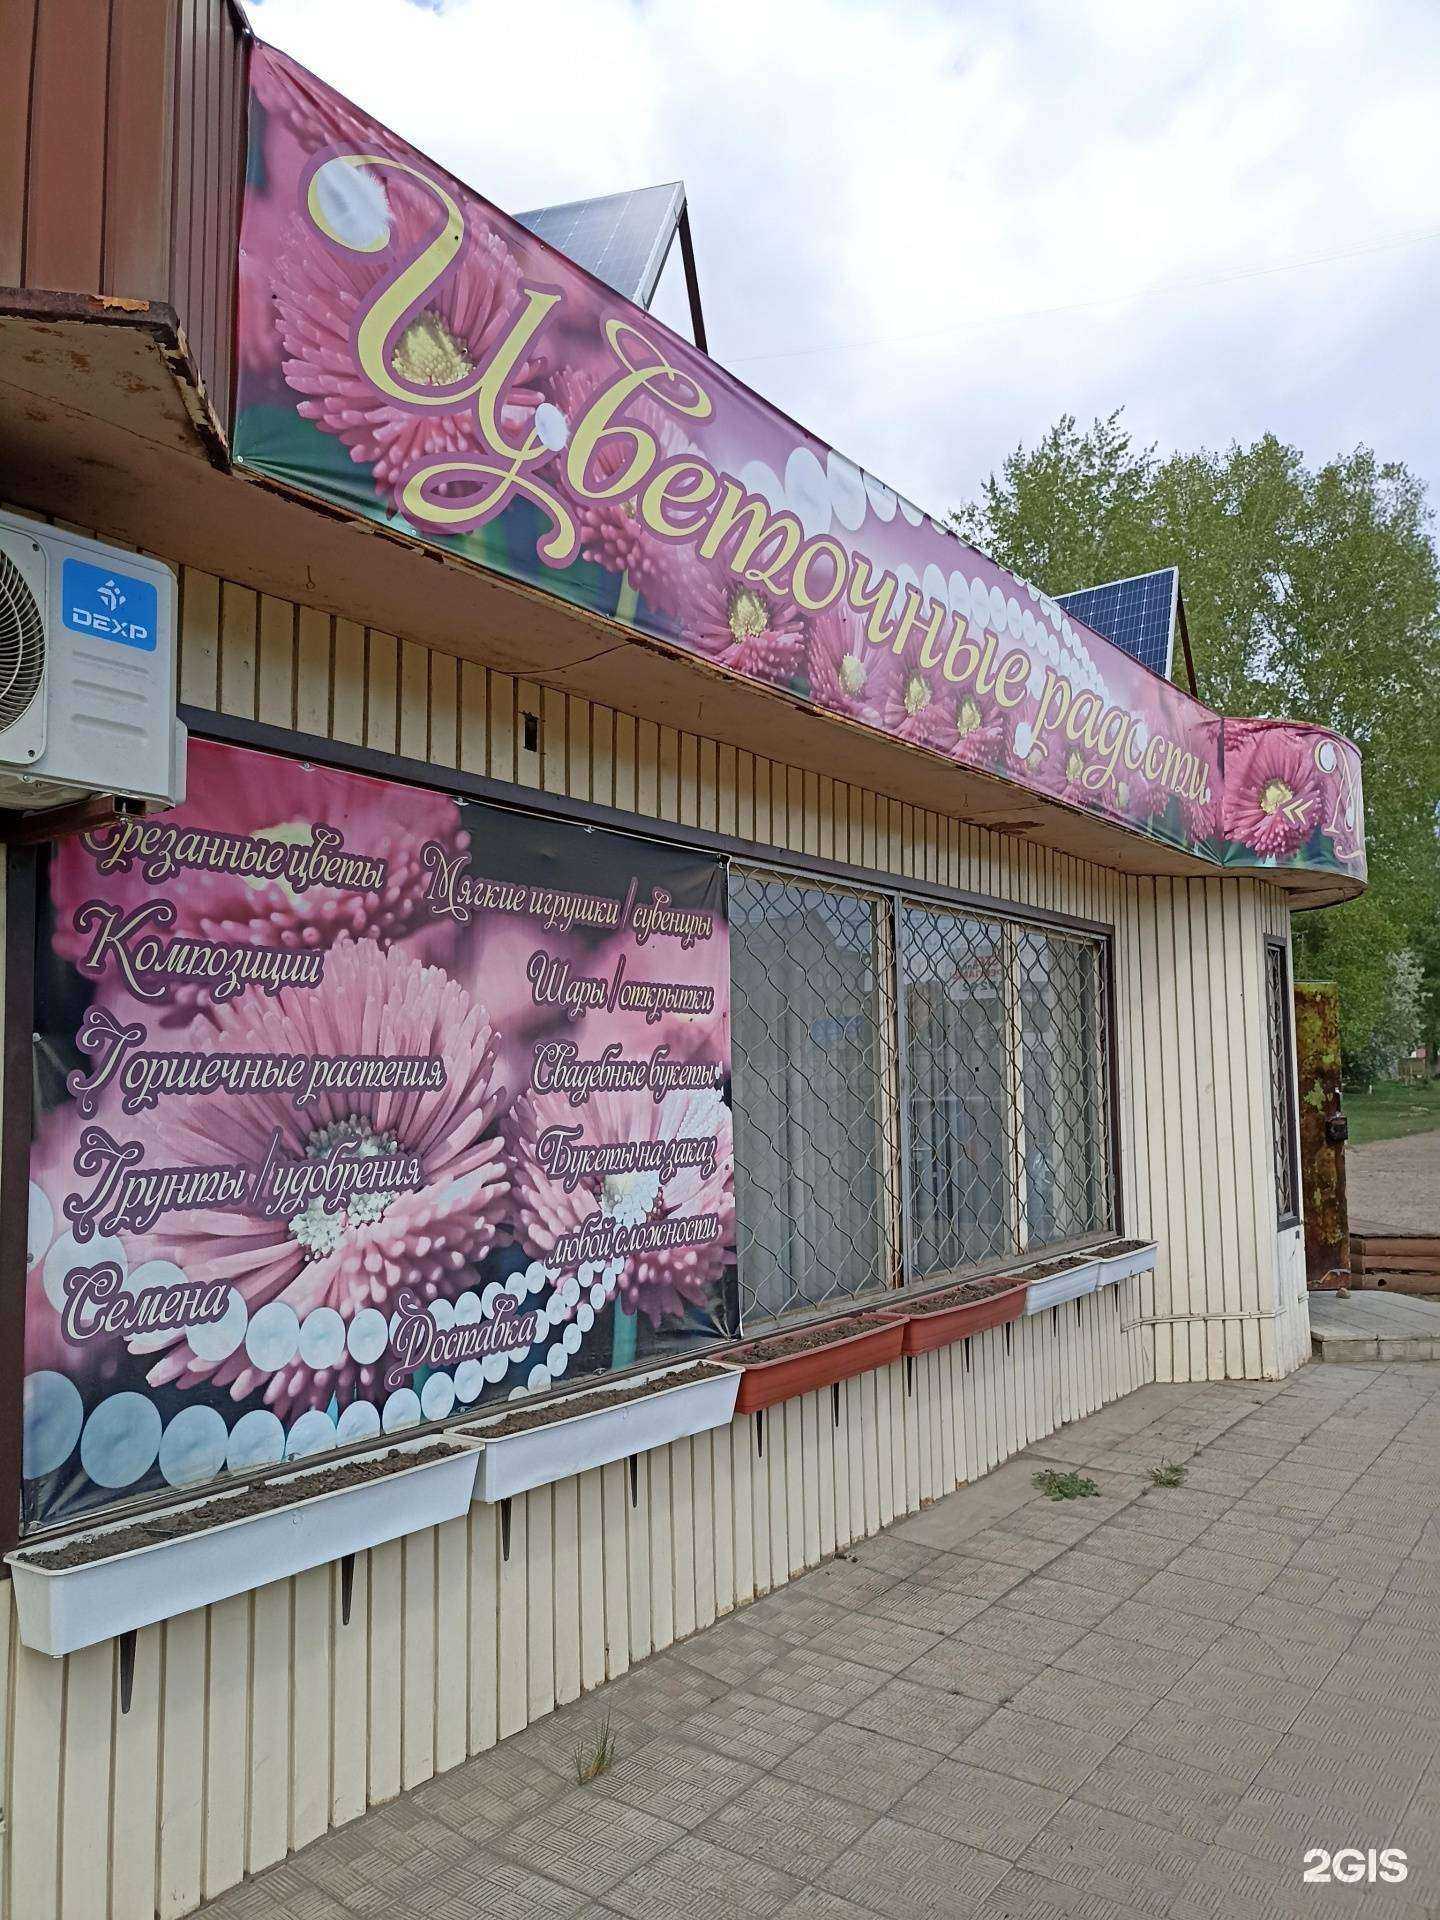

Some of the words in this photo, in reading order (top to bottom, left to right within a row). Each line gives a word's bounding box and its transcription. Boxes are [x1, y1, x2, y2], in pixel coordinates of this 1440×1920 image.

[307, 154, 1032, 708] Цветочные
[1028, 668, 1210, 806] радости
[72, 607, 148, 640] DEXP
[289, 828, 384, 888] цветы
[424, 846, 526, 921] Мягкие
[528, 888, 618, 931] игрушки
[633, 890, 712, 945] сувениры
[80, 905, 320, 998] Композиции
[73, 1011, 304, 1112] Горшечные
[297, 1060, 443, 1105] растения
[534, 1043, 647, 1102] Свадебные
[651, 1048, 714, 1098] букеты
[70, 1133, 246, 1233] Грунты
[538, 1129, 635, 1187] Букеты
[640, 1149, 662, 1166] на
[659, 1137, 717, 1176] заказ
[549, 1213, 612, 1264] любой
[616, 1218, 717, 1251] сложности
[67, 1270, 228, 1339] Семена
[387, 1293, 535, 1385] Доставка
